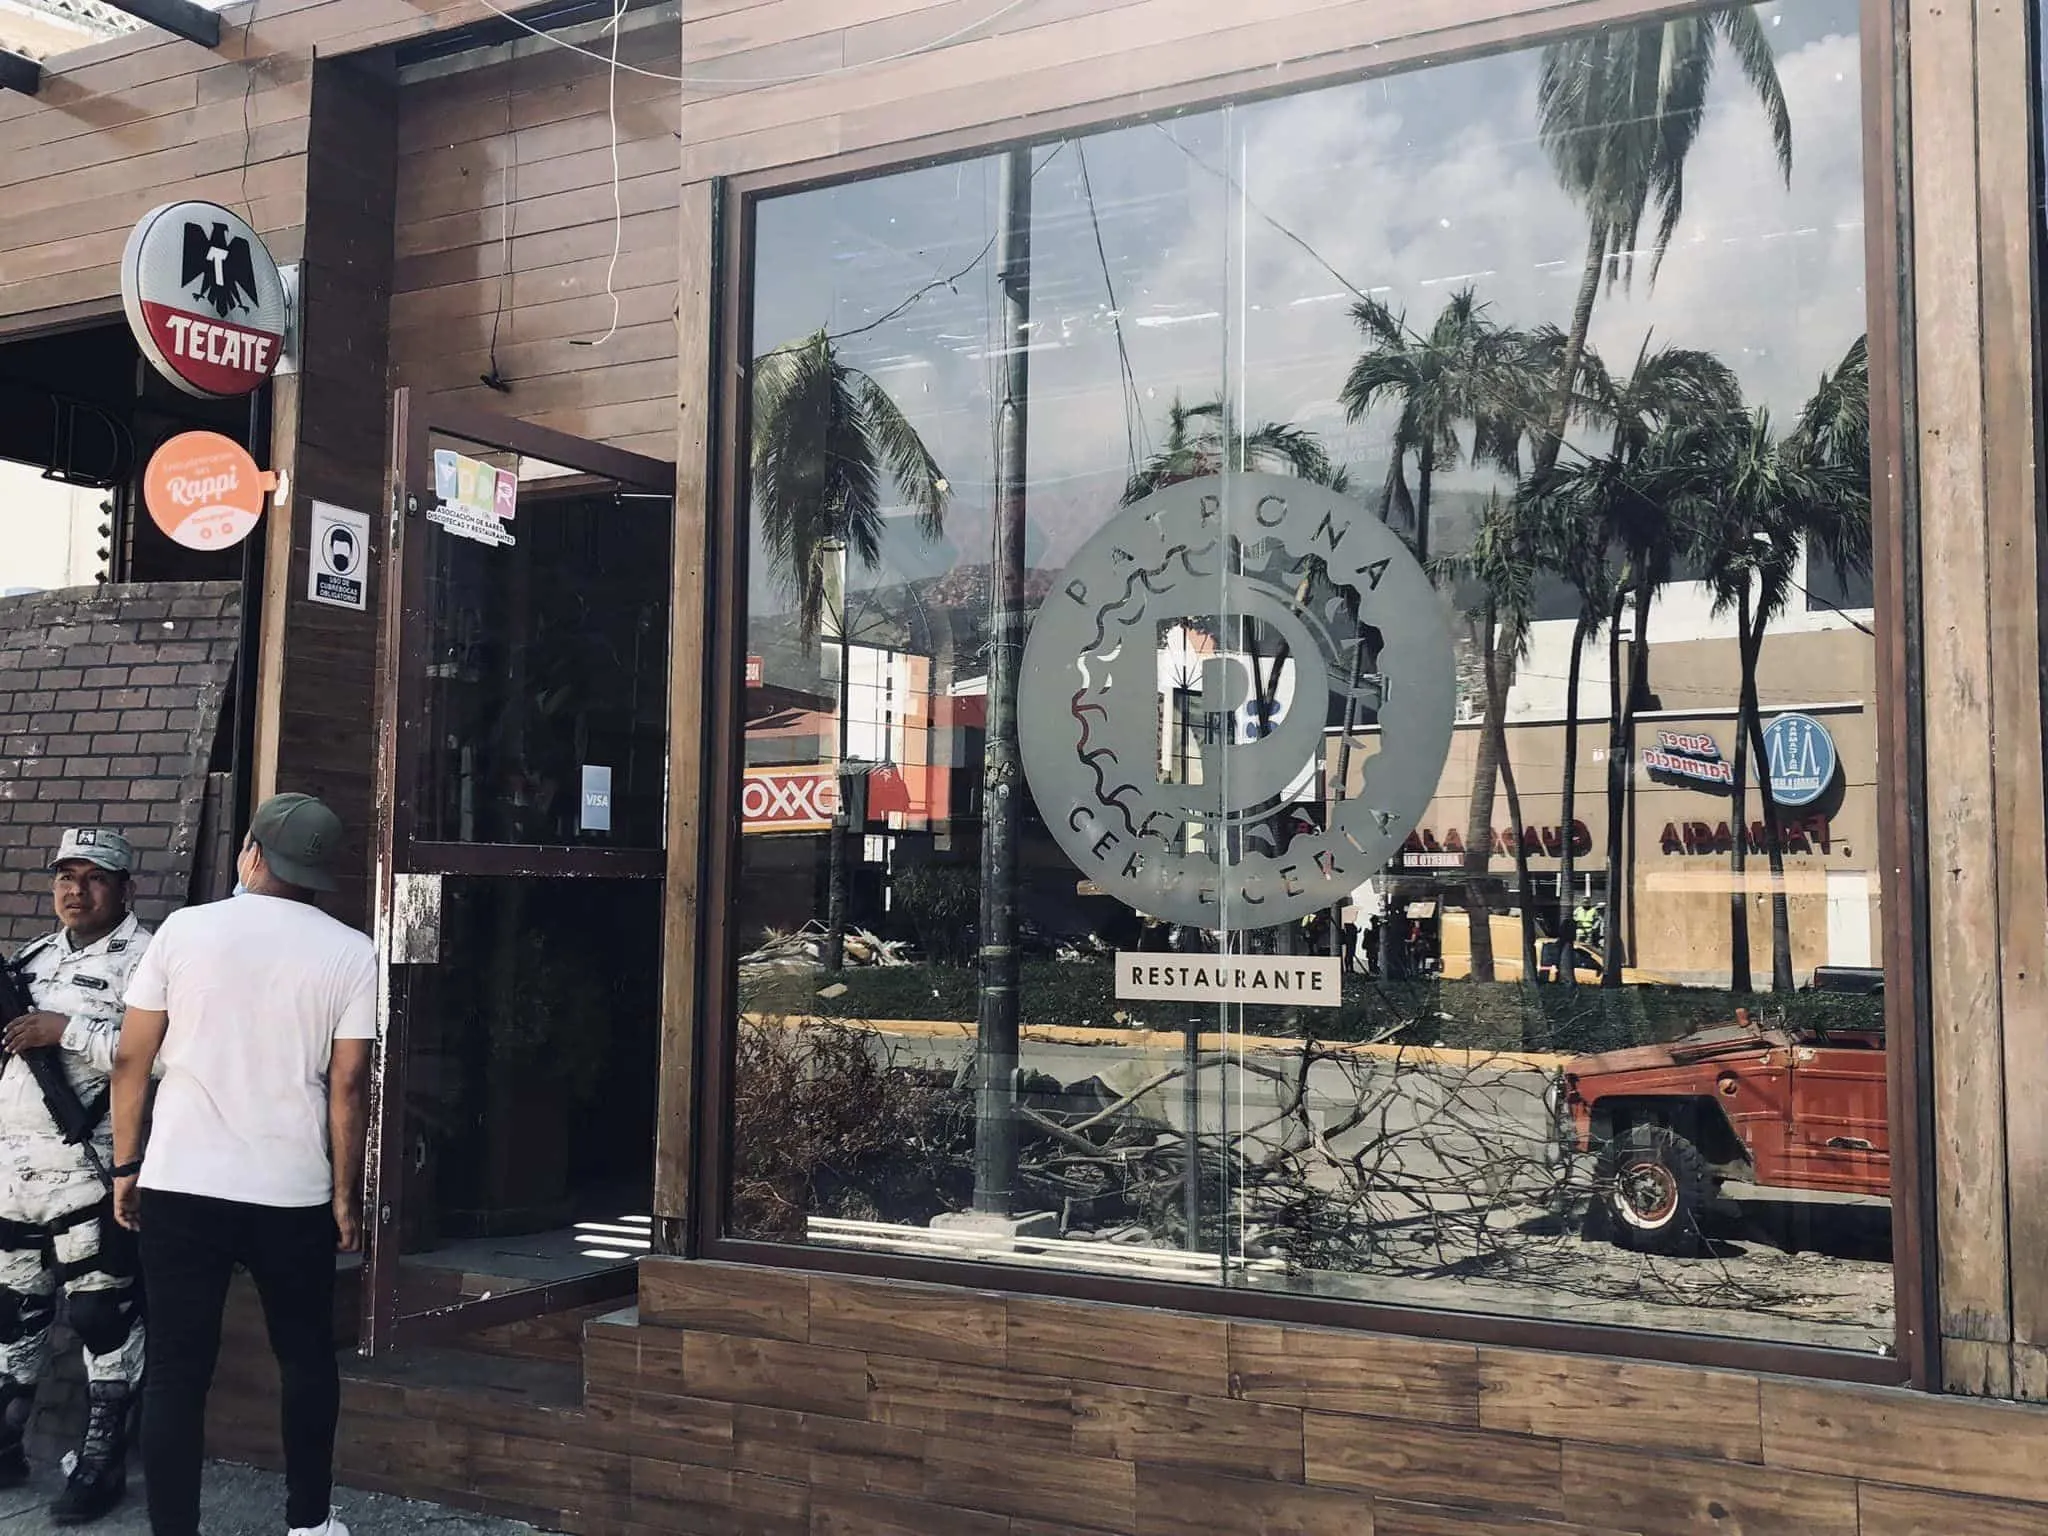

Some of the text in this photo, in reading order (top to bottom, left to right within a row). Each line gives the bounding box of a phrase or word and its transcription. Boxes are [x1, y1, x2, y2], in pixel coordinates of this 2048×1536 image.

[206, 246, 229, 286] T
[166, 315, 273, 374] TECATE
[166, 464, 239, 507] Rappi
[427, 511, 466, 528] DISCOTECAS
[471, 525, 514, 544] RESTAURANTES
[476, 518, 484, 526] DE
[1064, 494, 1392, 606] PATRONA
[586, 793, 609, 807] VISA
[1069, 806, 1400, 905] CERECERIA
[1131, 966, 1323, 991] RESTAURANTE
